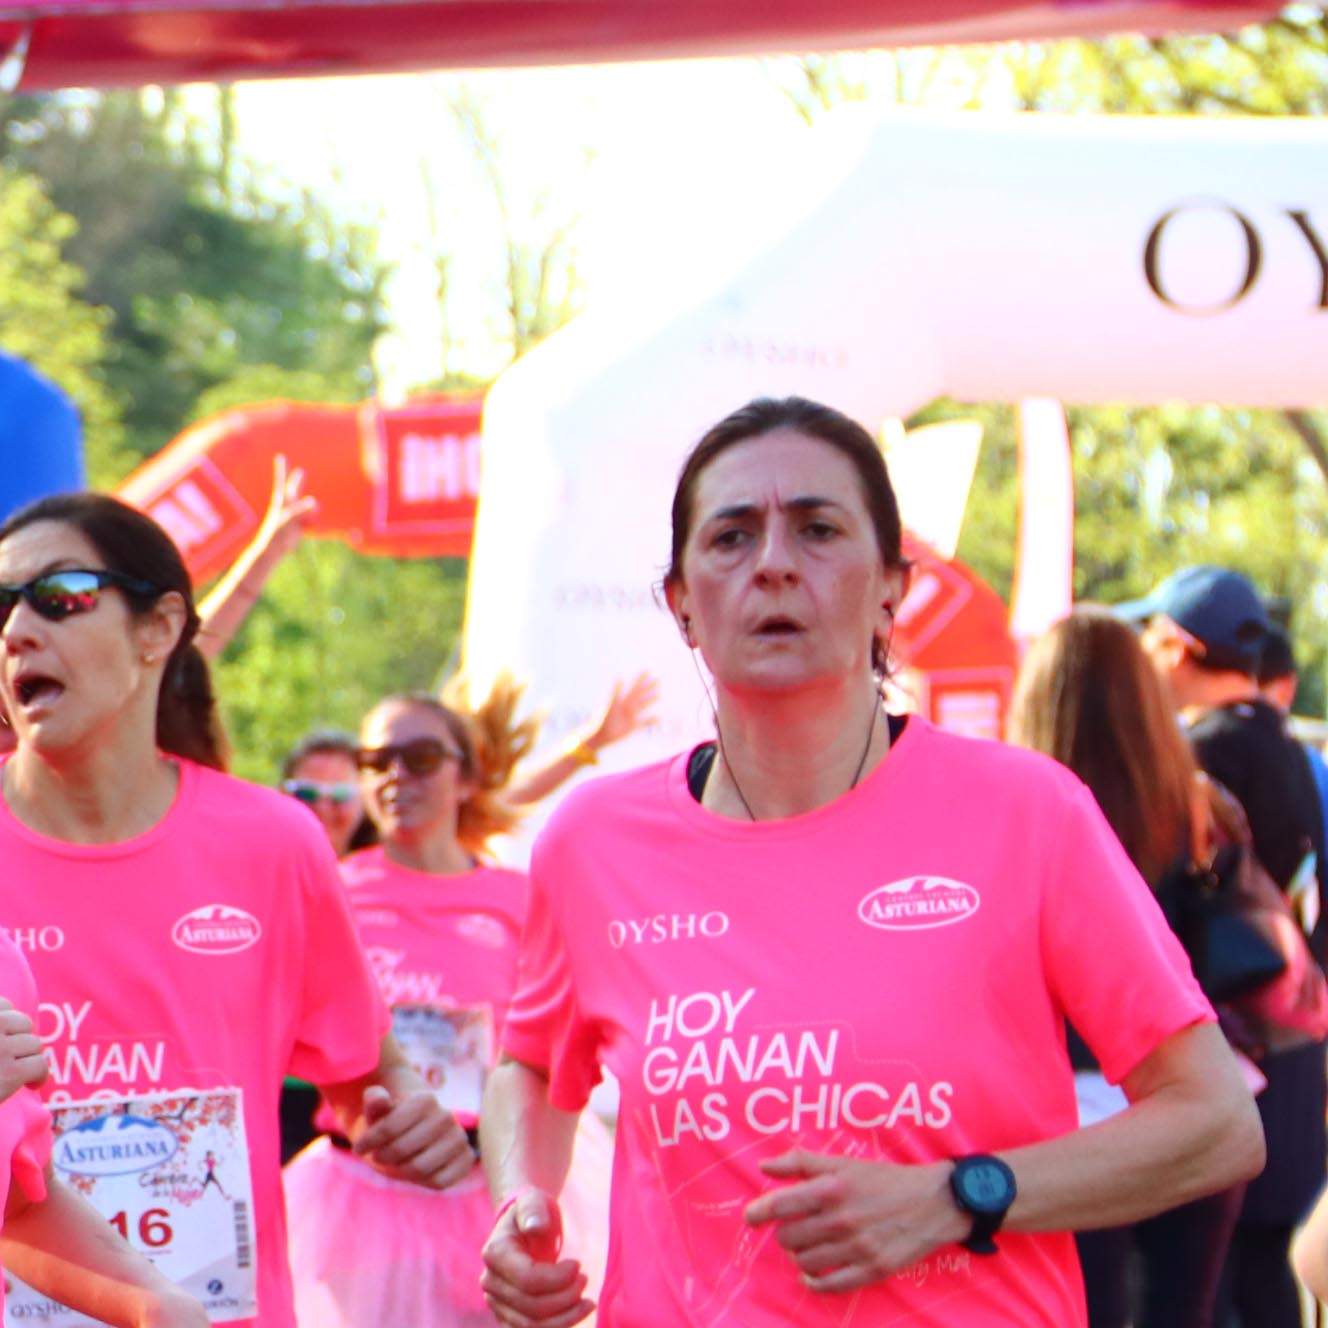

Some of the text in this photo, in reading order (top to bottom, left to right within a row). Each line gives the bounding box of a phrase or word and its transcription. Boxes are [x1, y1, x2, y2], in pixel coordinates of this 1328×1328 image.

[869, 897, 970, 920] ASTURIANA
[608, 912, 729, 949] OYSHO
[38, 1001, 92, 1044] OY
[646, 987, 756, 1045] HOY
[45, 1041, 164, 1085] ANAN
[643, 1029, 839, 1097] GANAN
[651, 1082, 953, 1147] LAS CHICAS
[60, 1140, 168, 1163] ASTURIANA
